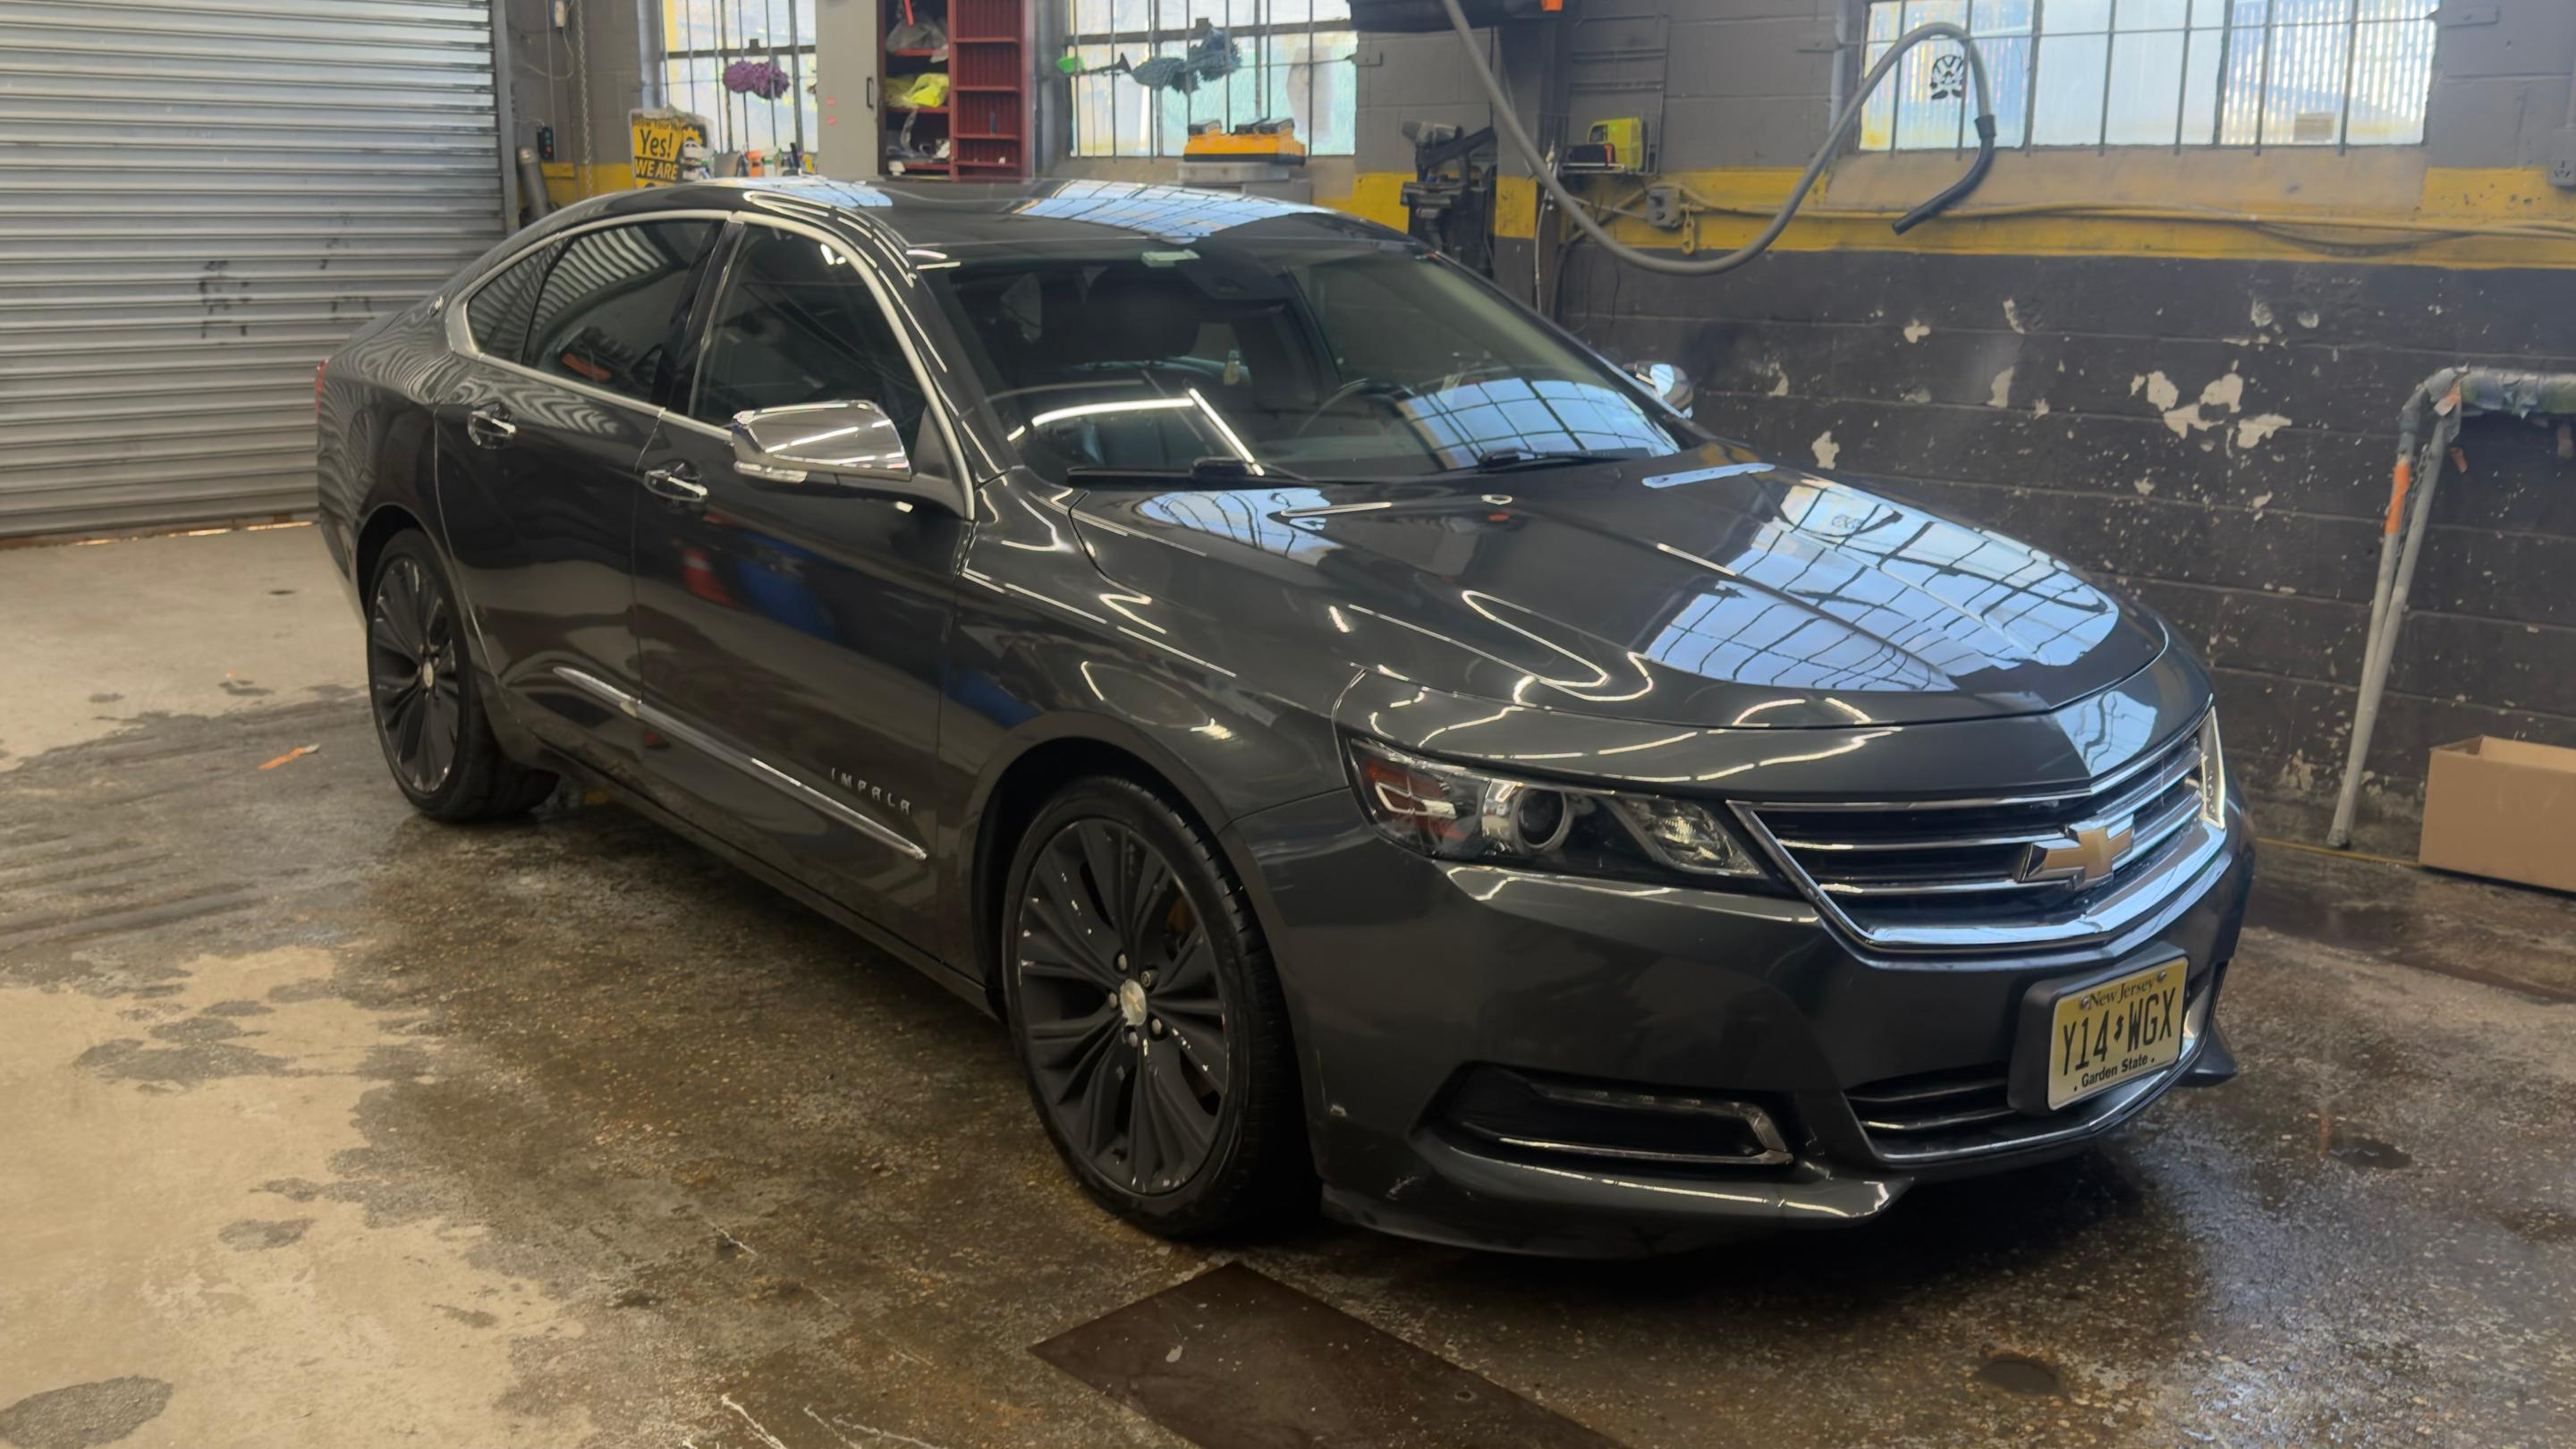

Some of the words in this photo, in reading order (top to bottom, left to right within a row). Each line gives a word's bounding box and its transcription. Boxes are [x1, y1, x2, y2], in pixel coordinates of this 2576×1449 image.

[640, 128, 674, 157] Yes!
[636, 158, 656, 178] WE
[656, 161, 679, 181] ARE
[831, 767, 911, 815] IMPALA
[2088, 990, 2117, 1011] New
[2117, 979, 2155, 1004] Jersey
[2081, 1066, 2118, 1088] Garden
[2121, 1054, 2148, 1072] State
